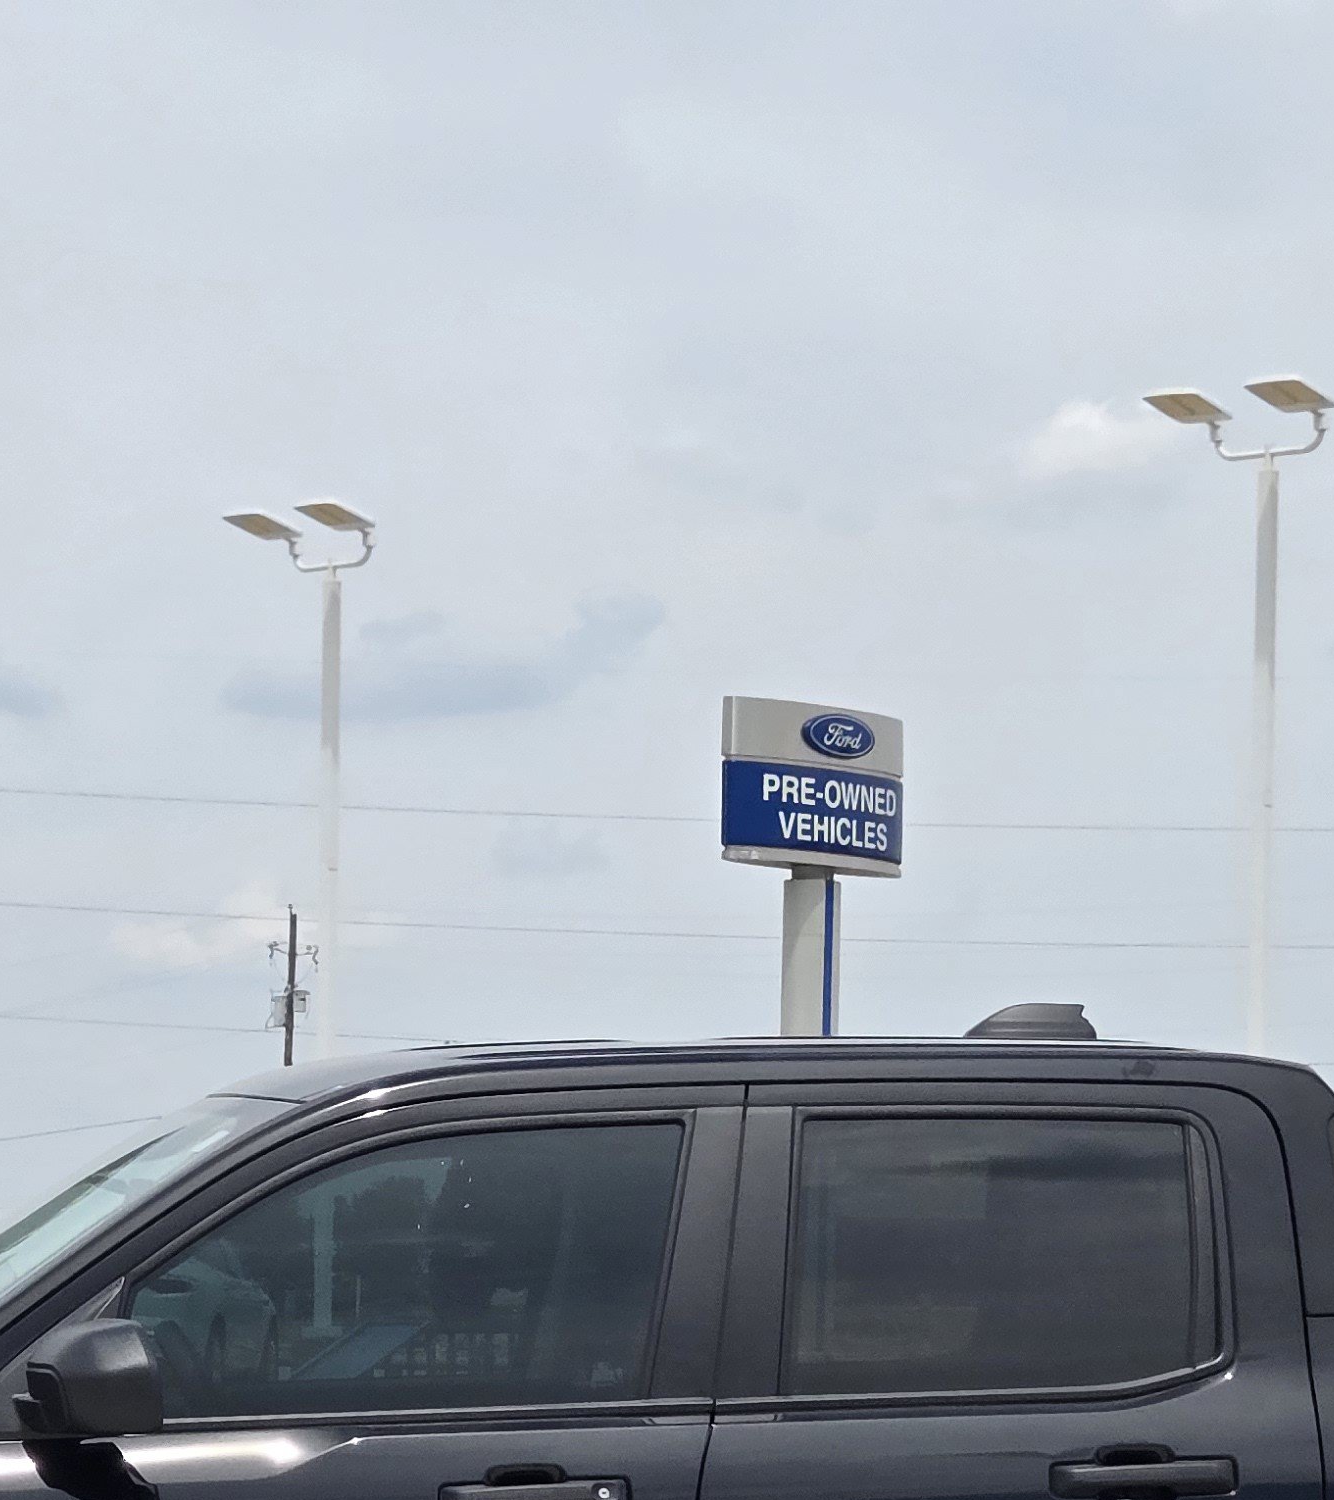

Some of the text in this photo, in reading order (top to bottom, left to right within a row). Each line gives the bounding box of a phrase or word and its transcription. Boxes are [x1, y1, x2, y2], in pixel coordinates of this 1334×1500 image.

[824, 722, 862, 750] Ford
[762, 773, 897, 817] PRE-OWNED
[778, 811, 888, 851] VEHICLES
